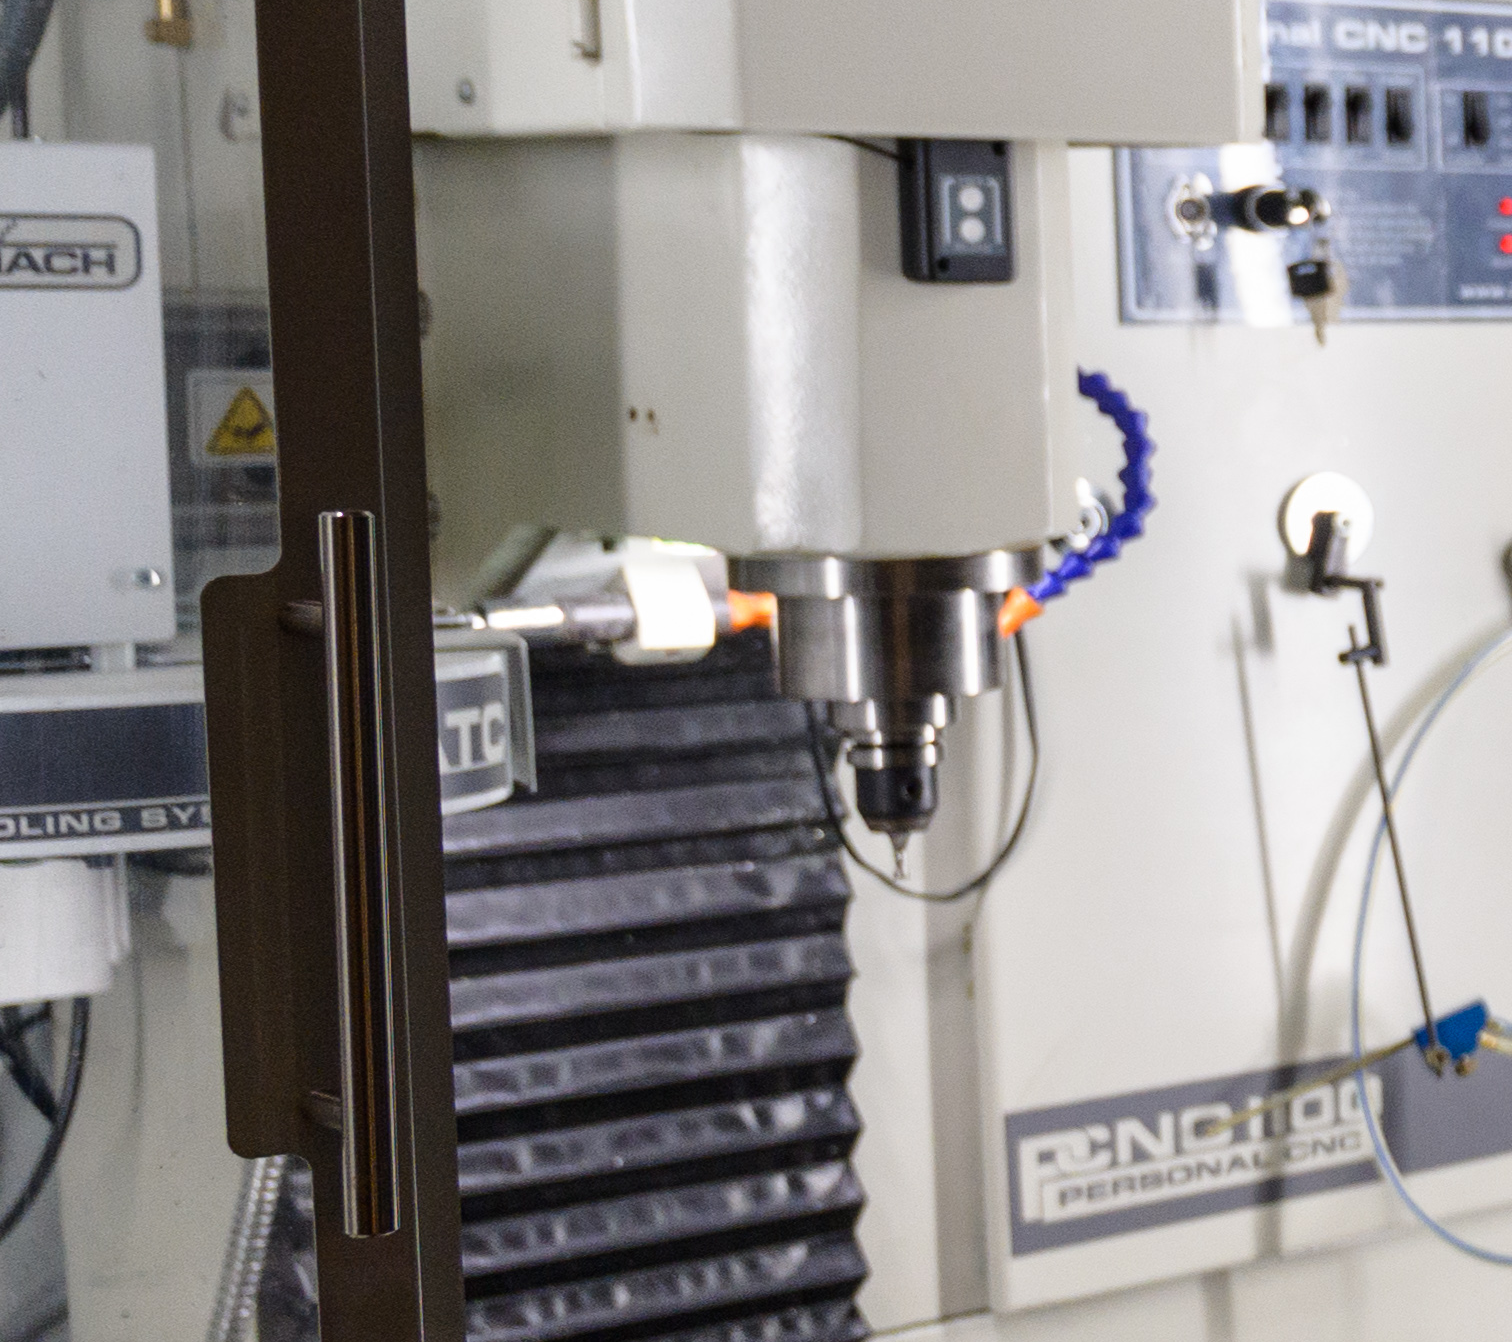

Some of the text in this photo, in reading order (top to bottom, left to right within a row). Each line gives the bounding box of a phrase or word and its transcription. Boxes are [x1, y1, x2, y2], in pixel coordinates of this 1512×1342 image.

[1333, 17, 1429, 54] CNC
[140, 804, 210, 830] SY
[1057, 1130, 1363, 1209] PERSONAL CNC
